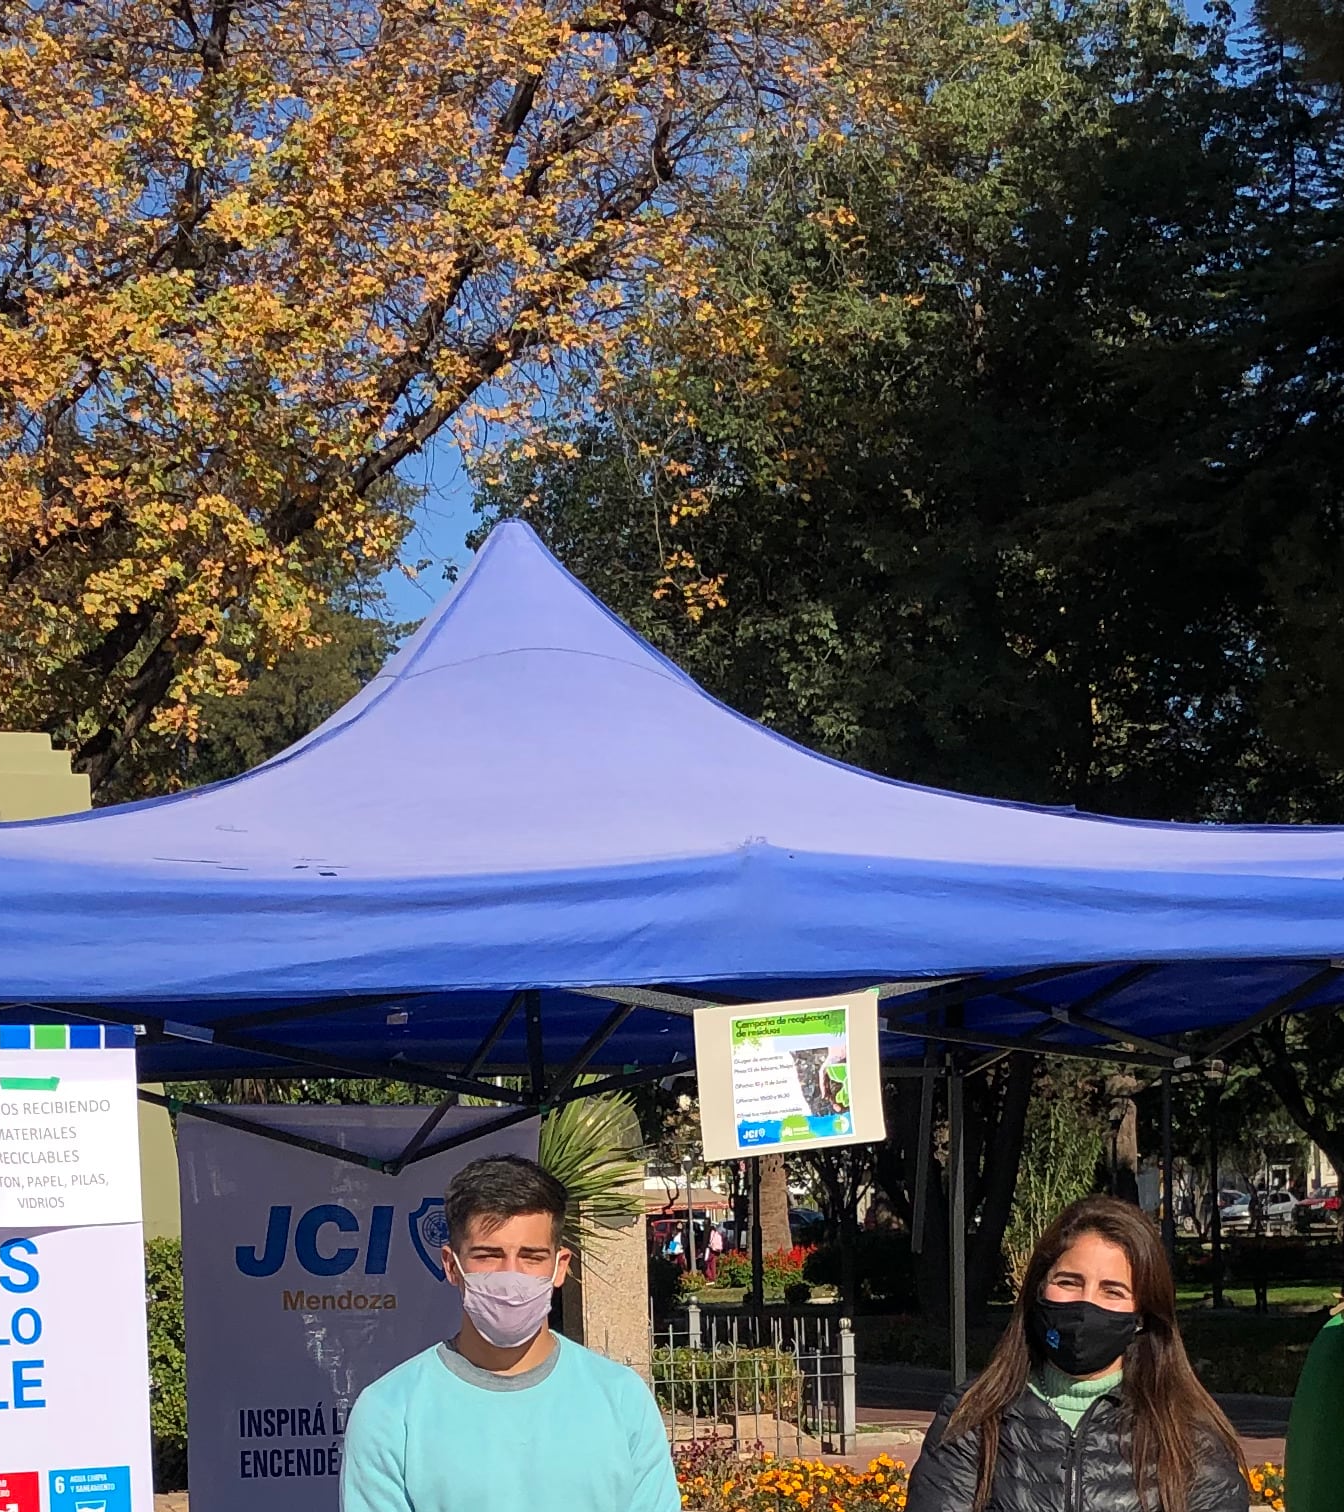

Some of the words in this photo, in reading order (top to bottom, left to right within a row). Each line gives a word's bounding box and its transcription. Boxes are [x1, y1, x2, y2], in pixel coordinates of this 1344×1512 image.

[776, 1016, 786, 1025] de
[736, 1029, 746, 1038] de
[747, 1028, 781, 1037] residuos
[23, 1099, 111, 1115] RECIBIENDO
[743, 1129, 759, 1140] JCI
[27, 1175, 67, 1189] PAPEL,
[71, 1173, 109, 1187] PILAS,
[17, 1196, 65, 1209] VIDRIOS
[235, 1204, 394, 1279] JCI
[283, 1289, 397, 1311] Mendoza
[239, 1402, 326, 1438] INSPIRÁ
[240, 1442, 339, 1479] ENCENDÉ
[54, 1476, 66, 1494] 6
[70, 1485, 75, 1493] Y
